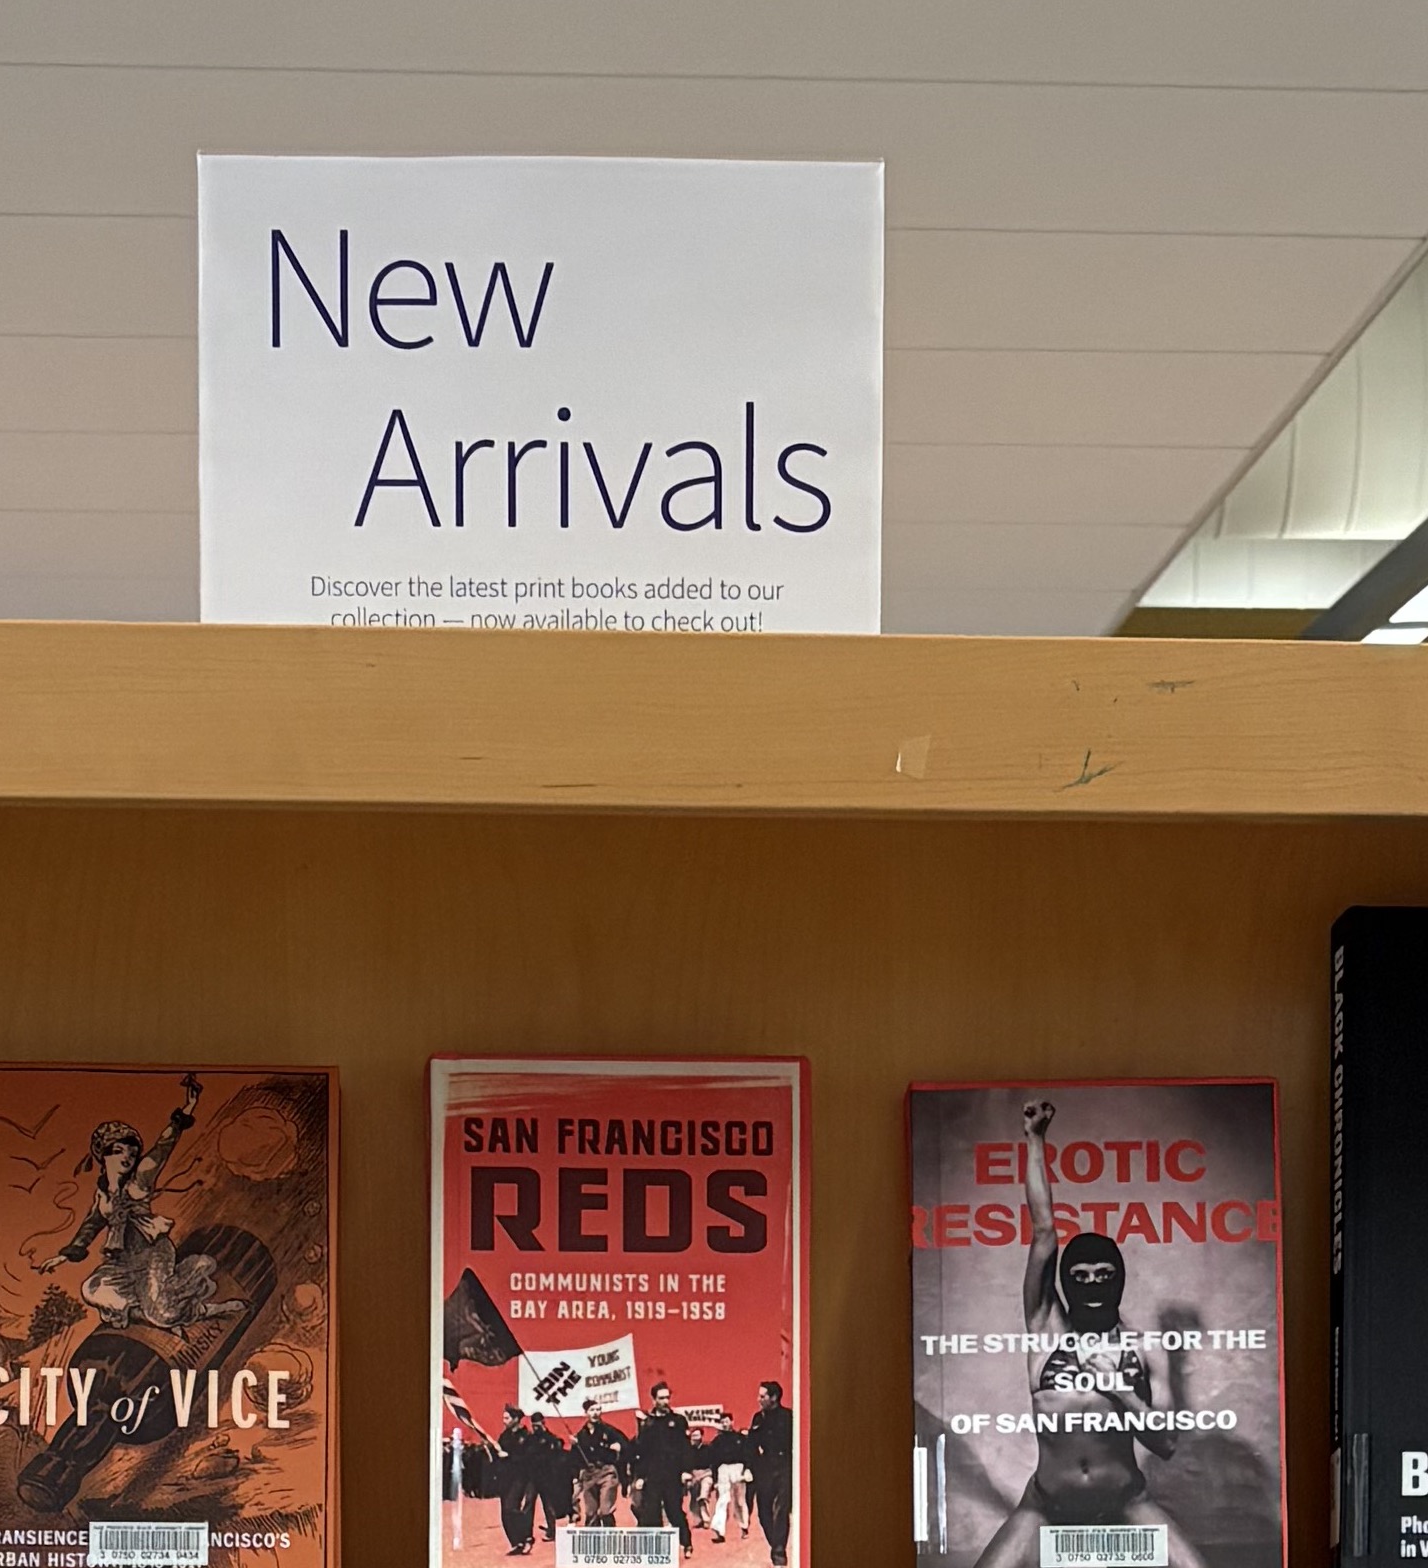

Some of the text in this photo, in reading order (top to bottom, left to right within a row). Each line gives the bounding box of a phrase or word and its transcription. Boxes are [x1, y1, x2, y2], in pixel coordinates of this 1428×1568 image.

[271, 228, 554, 350] New
[353, 401, 832, 534] Arrivals
[311, 576, 783, 603] Discover the latest print books added to our
[464, 1118, 774, 1156] SAN FRANCISCO
[975, 1140, 1207, 1185] EROTIC
[471, 1166, 768, 1253] REDS
[510, 1273, 726, 1293] COMMUNISTS IN THE
[510, 1301, 546, 1319] BAY
[558, 1301, 617, 1322] AREA,
[1054, 1371, 1134, 1393] SOUL
[111, 1385, 159, 1433] of
[170, 1369, 290, 1429] VICE
[950, 1410, 1237, 1434] OF SAN FRANCISCO
[1401, 1541, 1416, 1558] in
